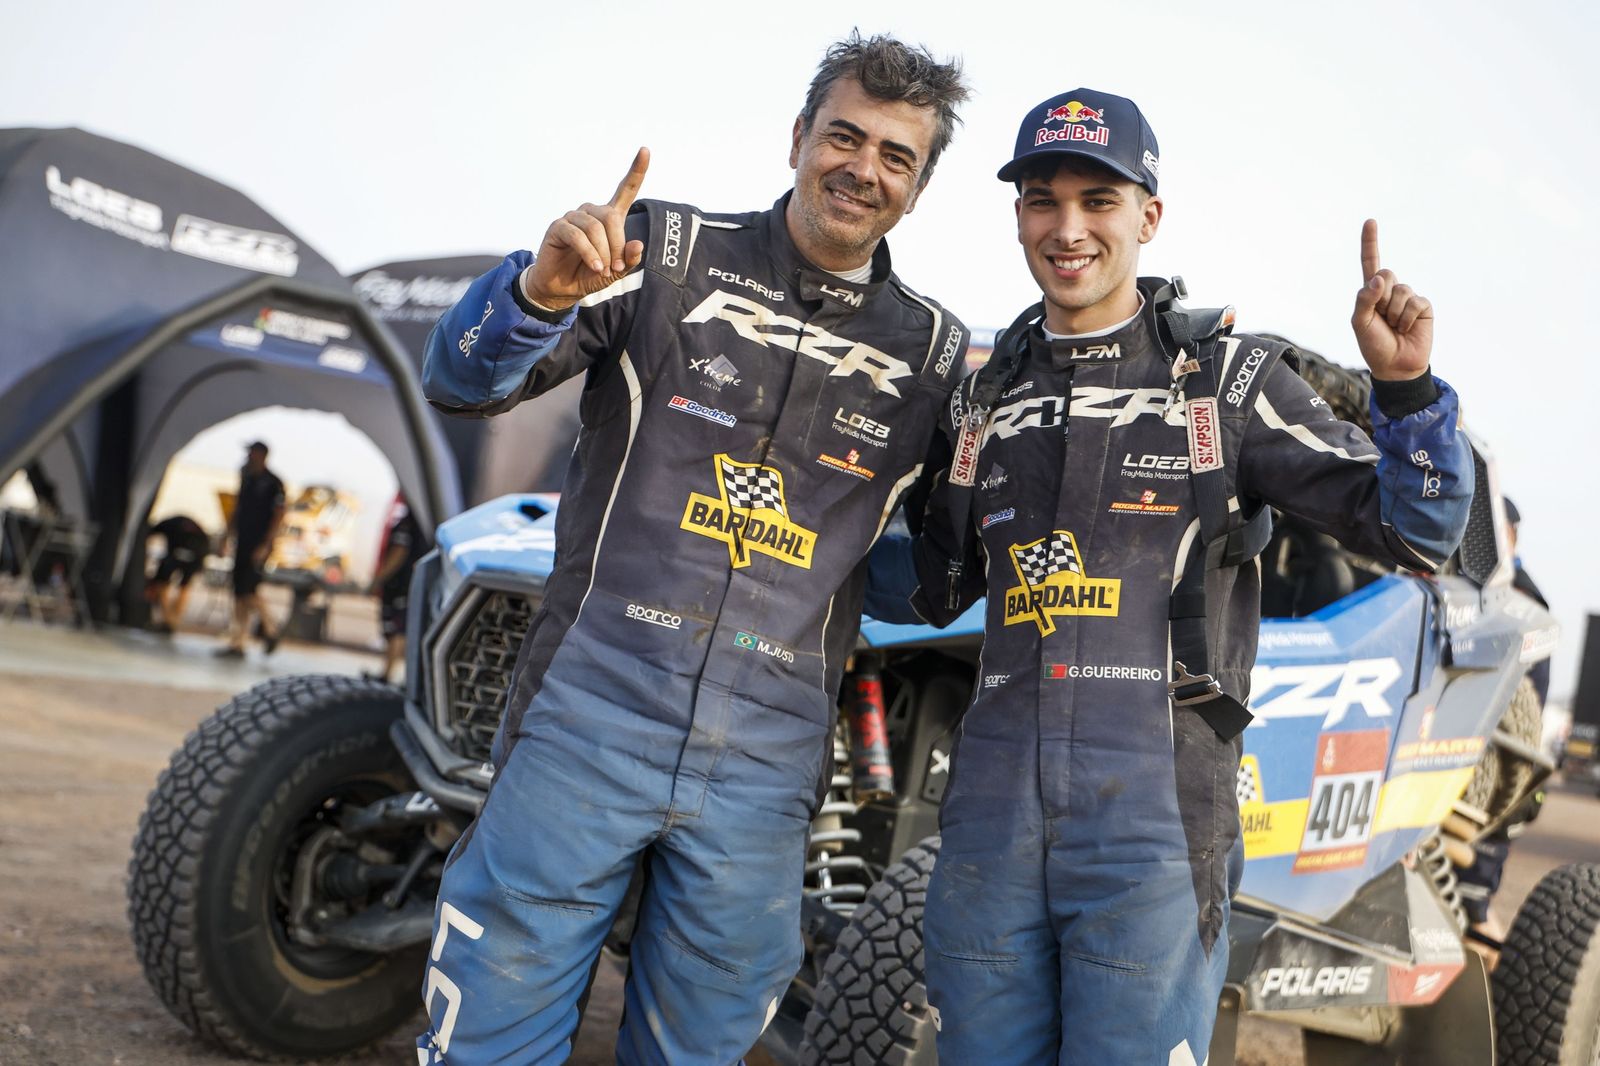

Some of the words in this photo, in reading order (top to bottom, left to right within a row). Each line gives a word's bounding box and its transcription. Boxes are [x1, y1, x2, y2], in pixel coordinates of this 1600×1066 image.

[1034, 123, 1071, 147] Red
[1070, 124, 1110, 147] Bull
[663, 210, 682, 267] sparco
[708, 266, 785, 301] POLARIS
[820, 284, 864, 308] LFM
[681, 289, 913, 398] RZR
[935, 325, 961, 378] sparco
[1071, 343, 1122, 361] LFM
[1002, 381, 1034, 399] LARIS
[1226, 347, 1266, 407] sparco
[670, 396, 737, 425] BFGoodrich
[835, 407, 890, 439] LOEB
[860, 433, 888, 449] Motorsport
[1193, 406, 1215, 464] SIMPSON
[819, 453, 848, 468] ROGER
[956, 430, 977, 480] SIMPSO
[1122, 453, 1189, 470] LOEB
[1154, 471, 1189, 481] Motorsport
[1111, 502, 1142, 510] ROGER
[1143, 504, 1180, 512] MARTIN
[688, 501, 807, 561] BARDAHL
[626, 604, 681, 627] sparco
[1007, 585, 1113, 620] BARDAHL
[1068, 665, 1162, 681] G.GUERREIRO
[1308, 779, 1374, 842] 404
[1260, 965, 1375, 998] POLARIS
